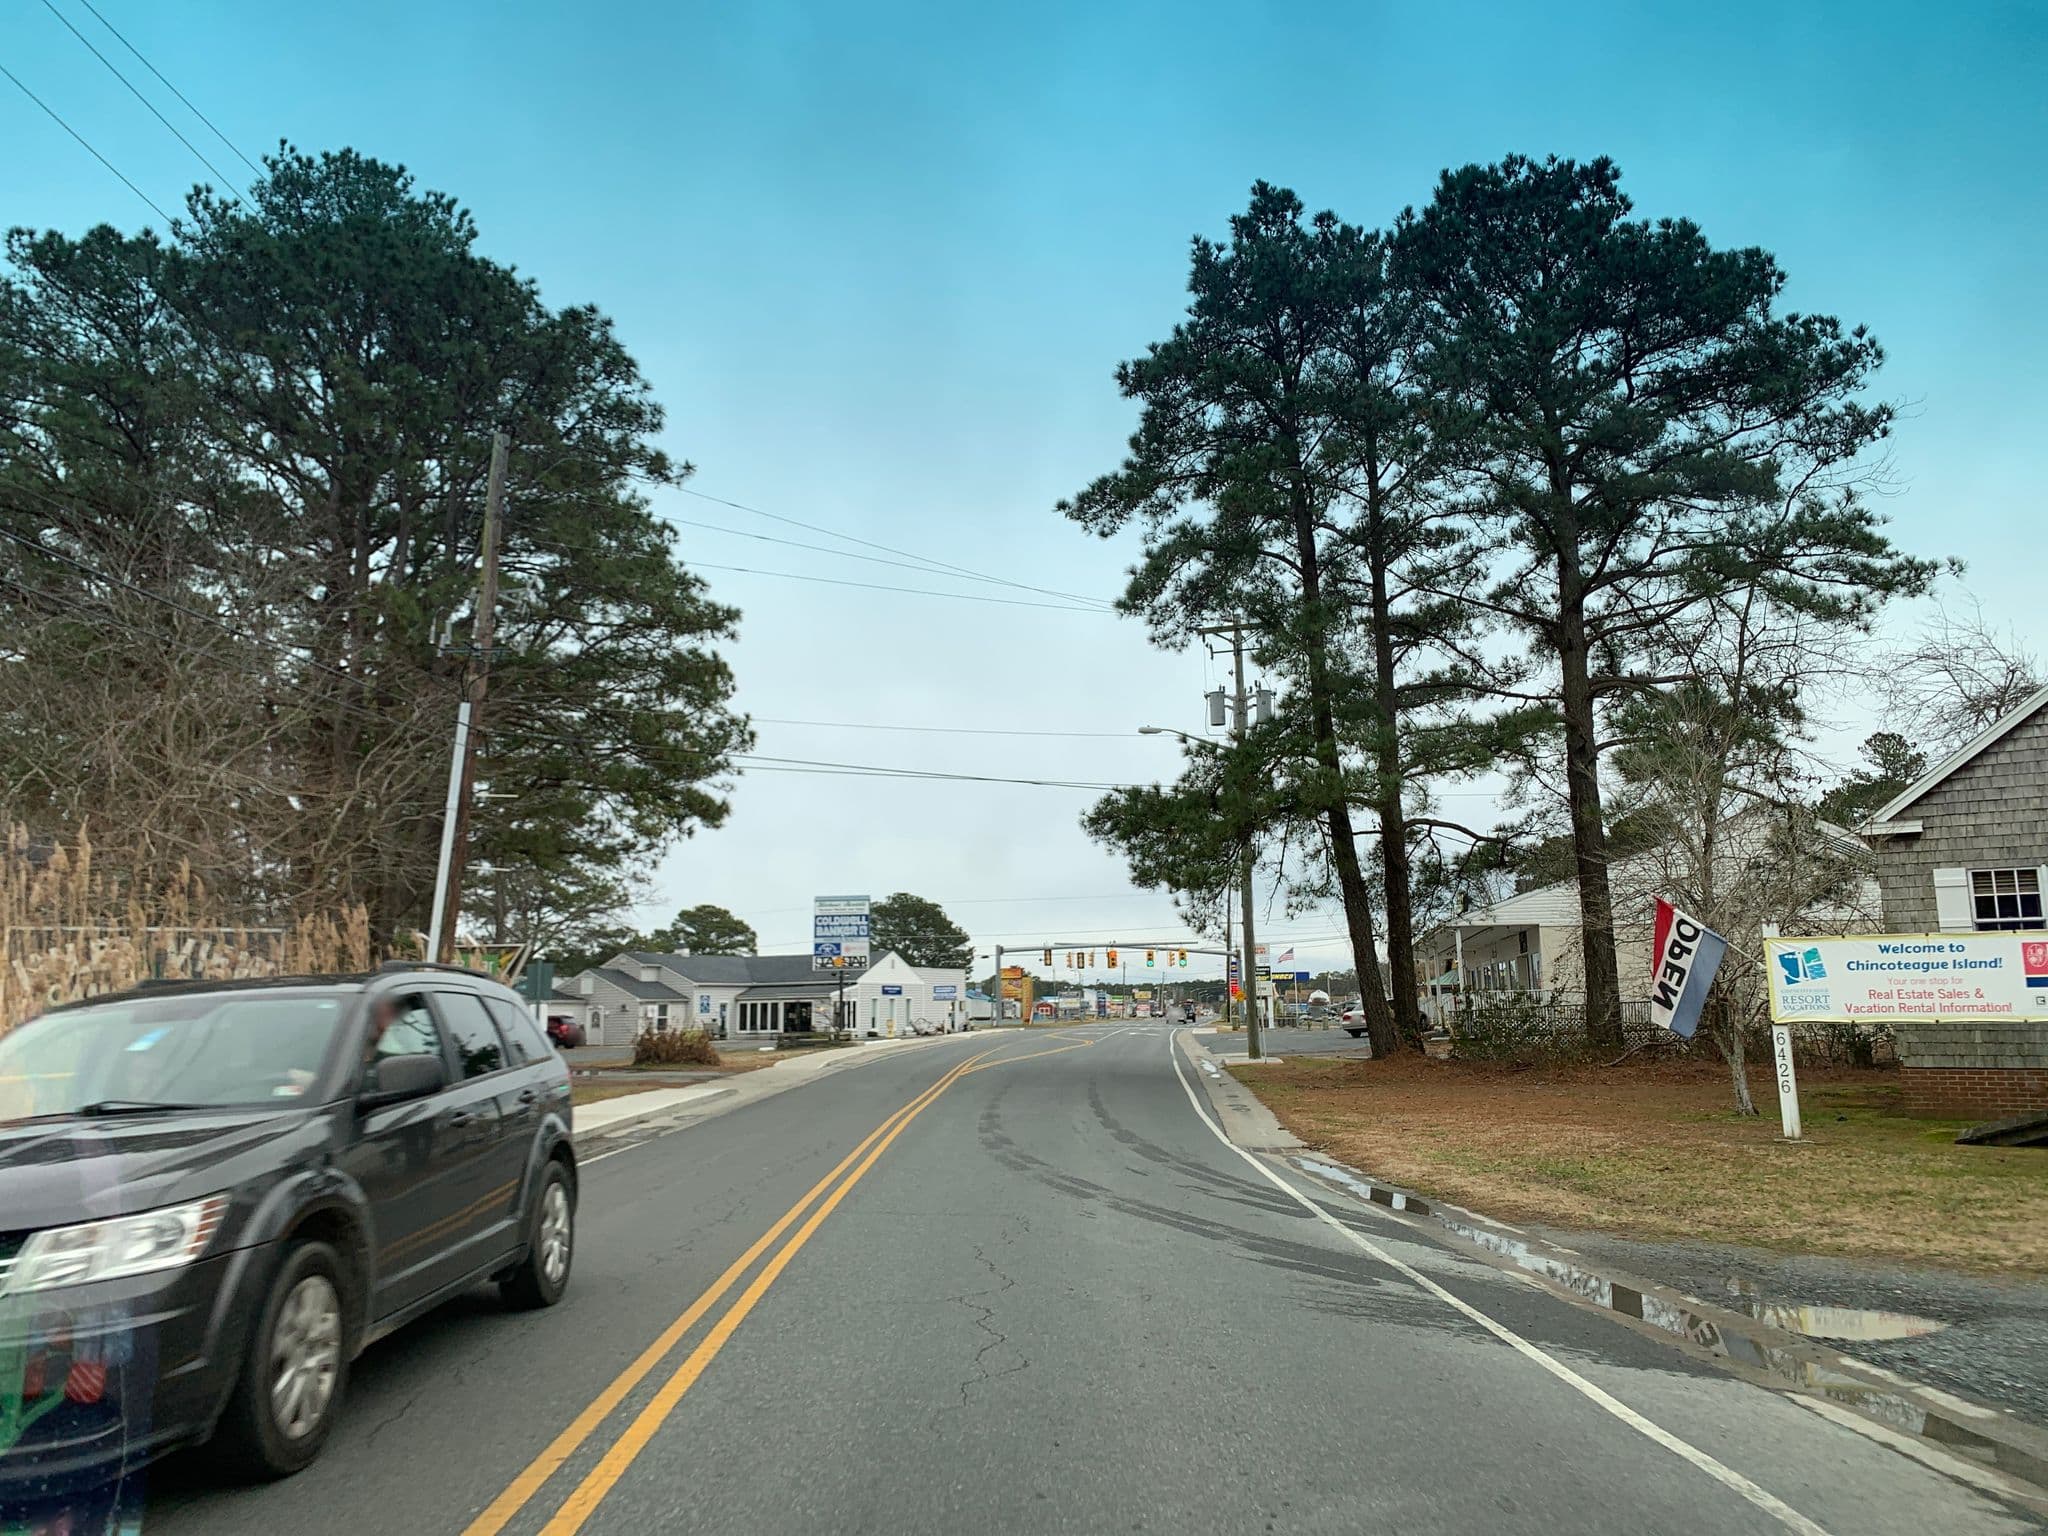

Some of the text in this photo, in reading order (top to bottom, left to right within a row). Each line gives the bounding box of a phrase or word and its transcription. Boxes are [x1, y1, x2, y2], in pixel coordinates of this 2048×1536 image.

[1878, 943, 1965, 954] Welcome to
[1847, 957, 2003, 973] Chincoteague Island!
[1887, 977, 1908, 986] Your
[1929, 977, 1949, 986] stop
[1868, 987, 1984, 1000] Real Estate Sales &
[1782, 995, 1831, 1005] RESORT
[1845, 1002, 2013, 1014] Vacation Rental Information!
[1776, 1032, 1791, 1094] 6426
